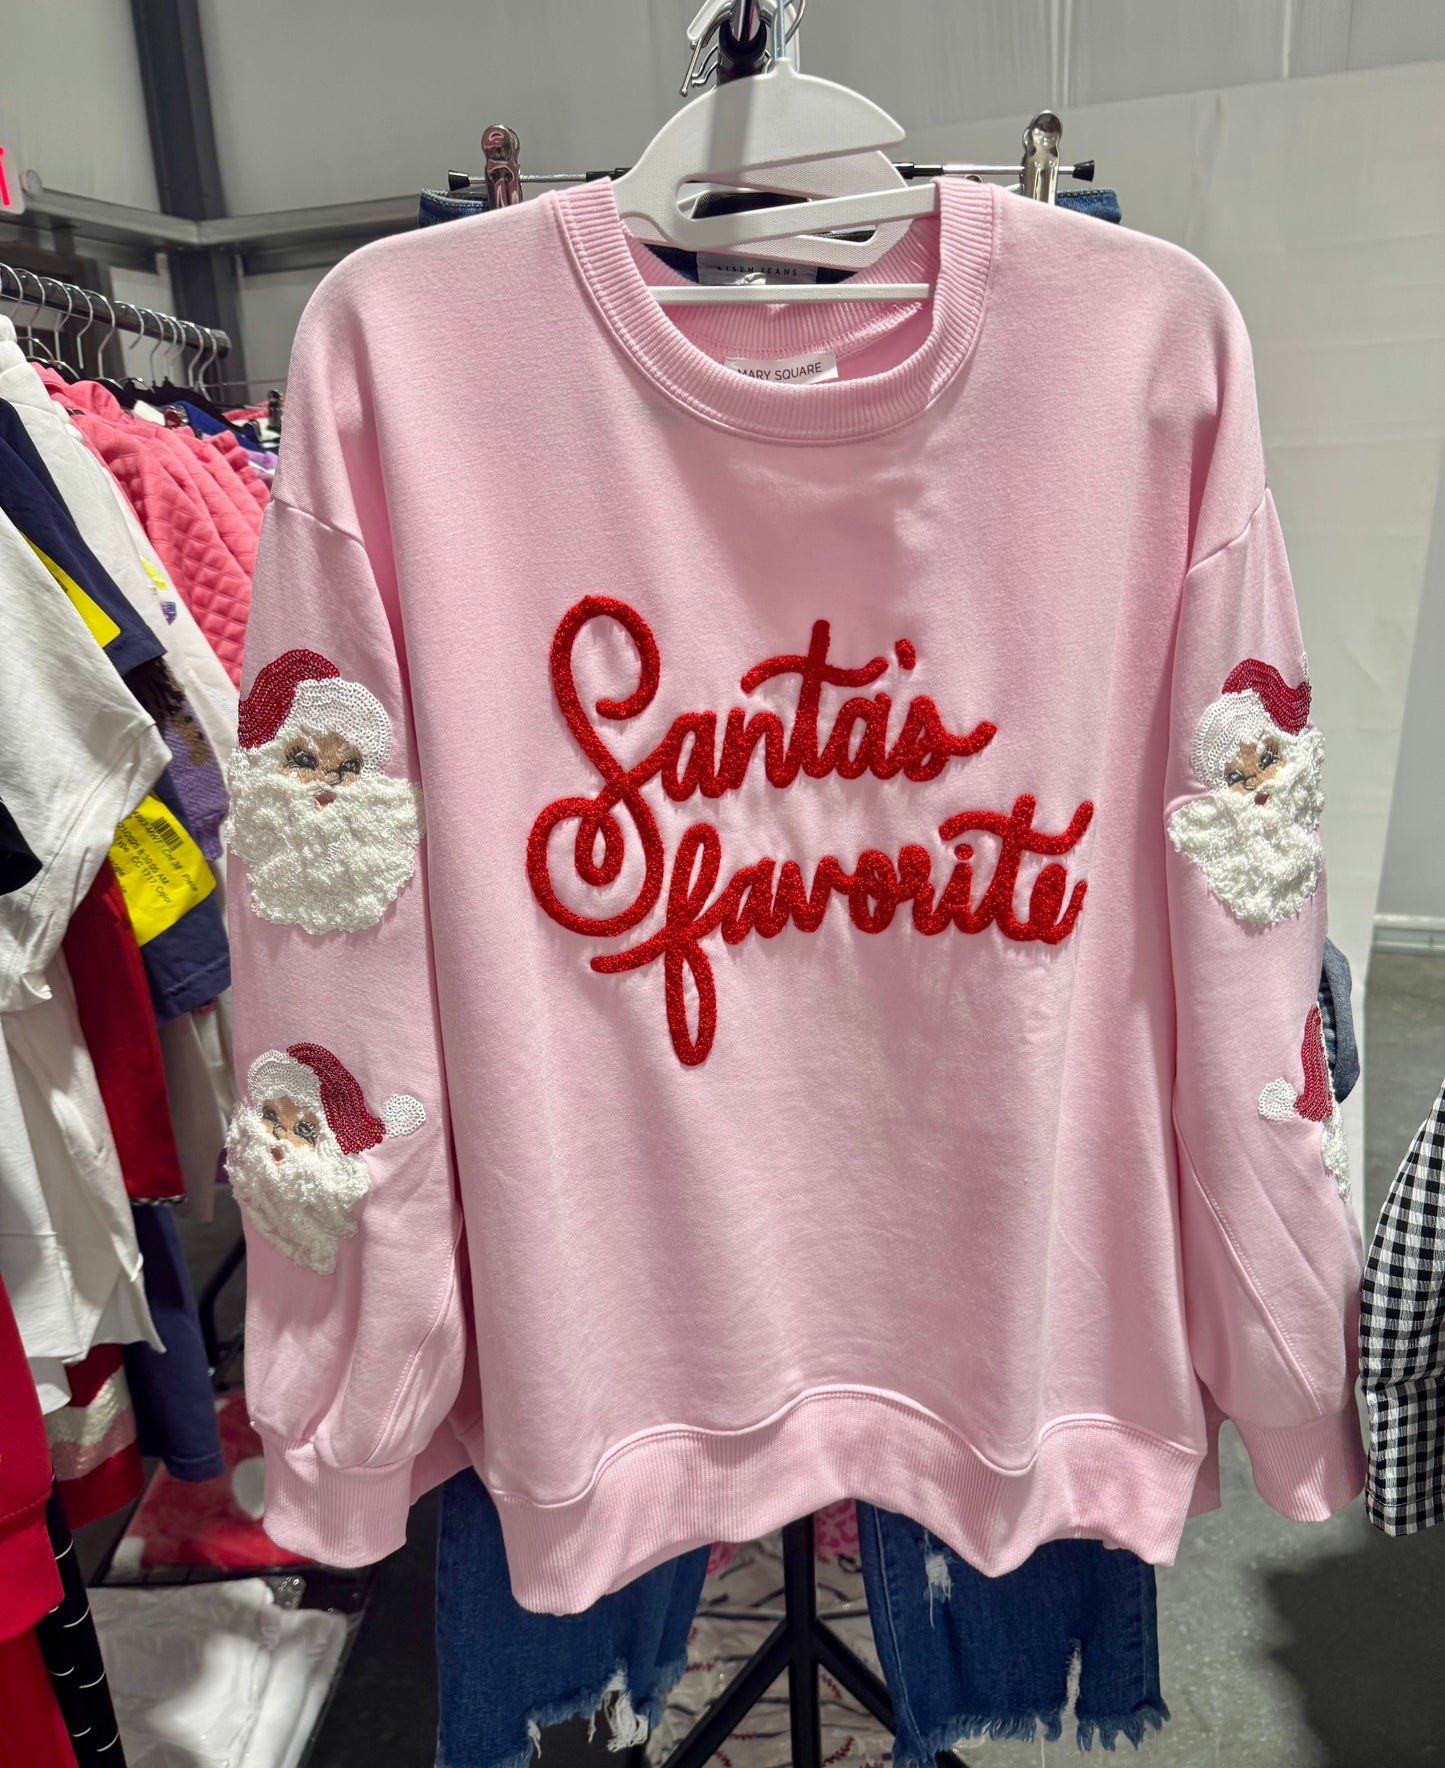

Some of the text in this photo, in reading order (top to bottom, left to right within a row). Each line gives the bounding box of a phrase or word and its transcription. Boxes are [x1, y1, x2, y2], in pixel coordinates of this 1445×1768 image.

[738, 362, 822, 381] MARY SQUARE
[527, 595, 997, 936] Santa's
[130, 855, 144, 868] CC
[156, 871, 170, 885] AM
[590, 794, 1093, 1065] favorite
